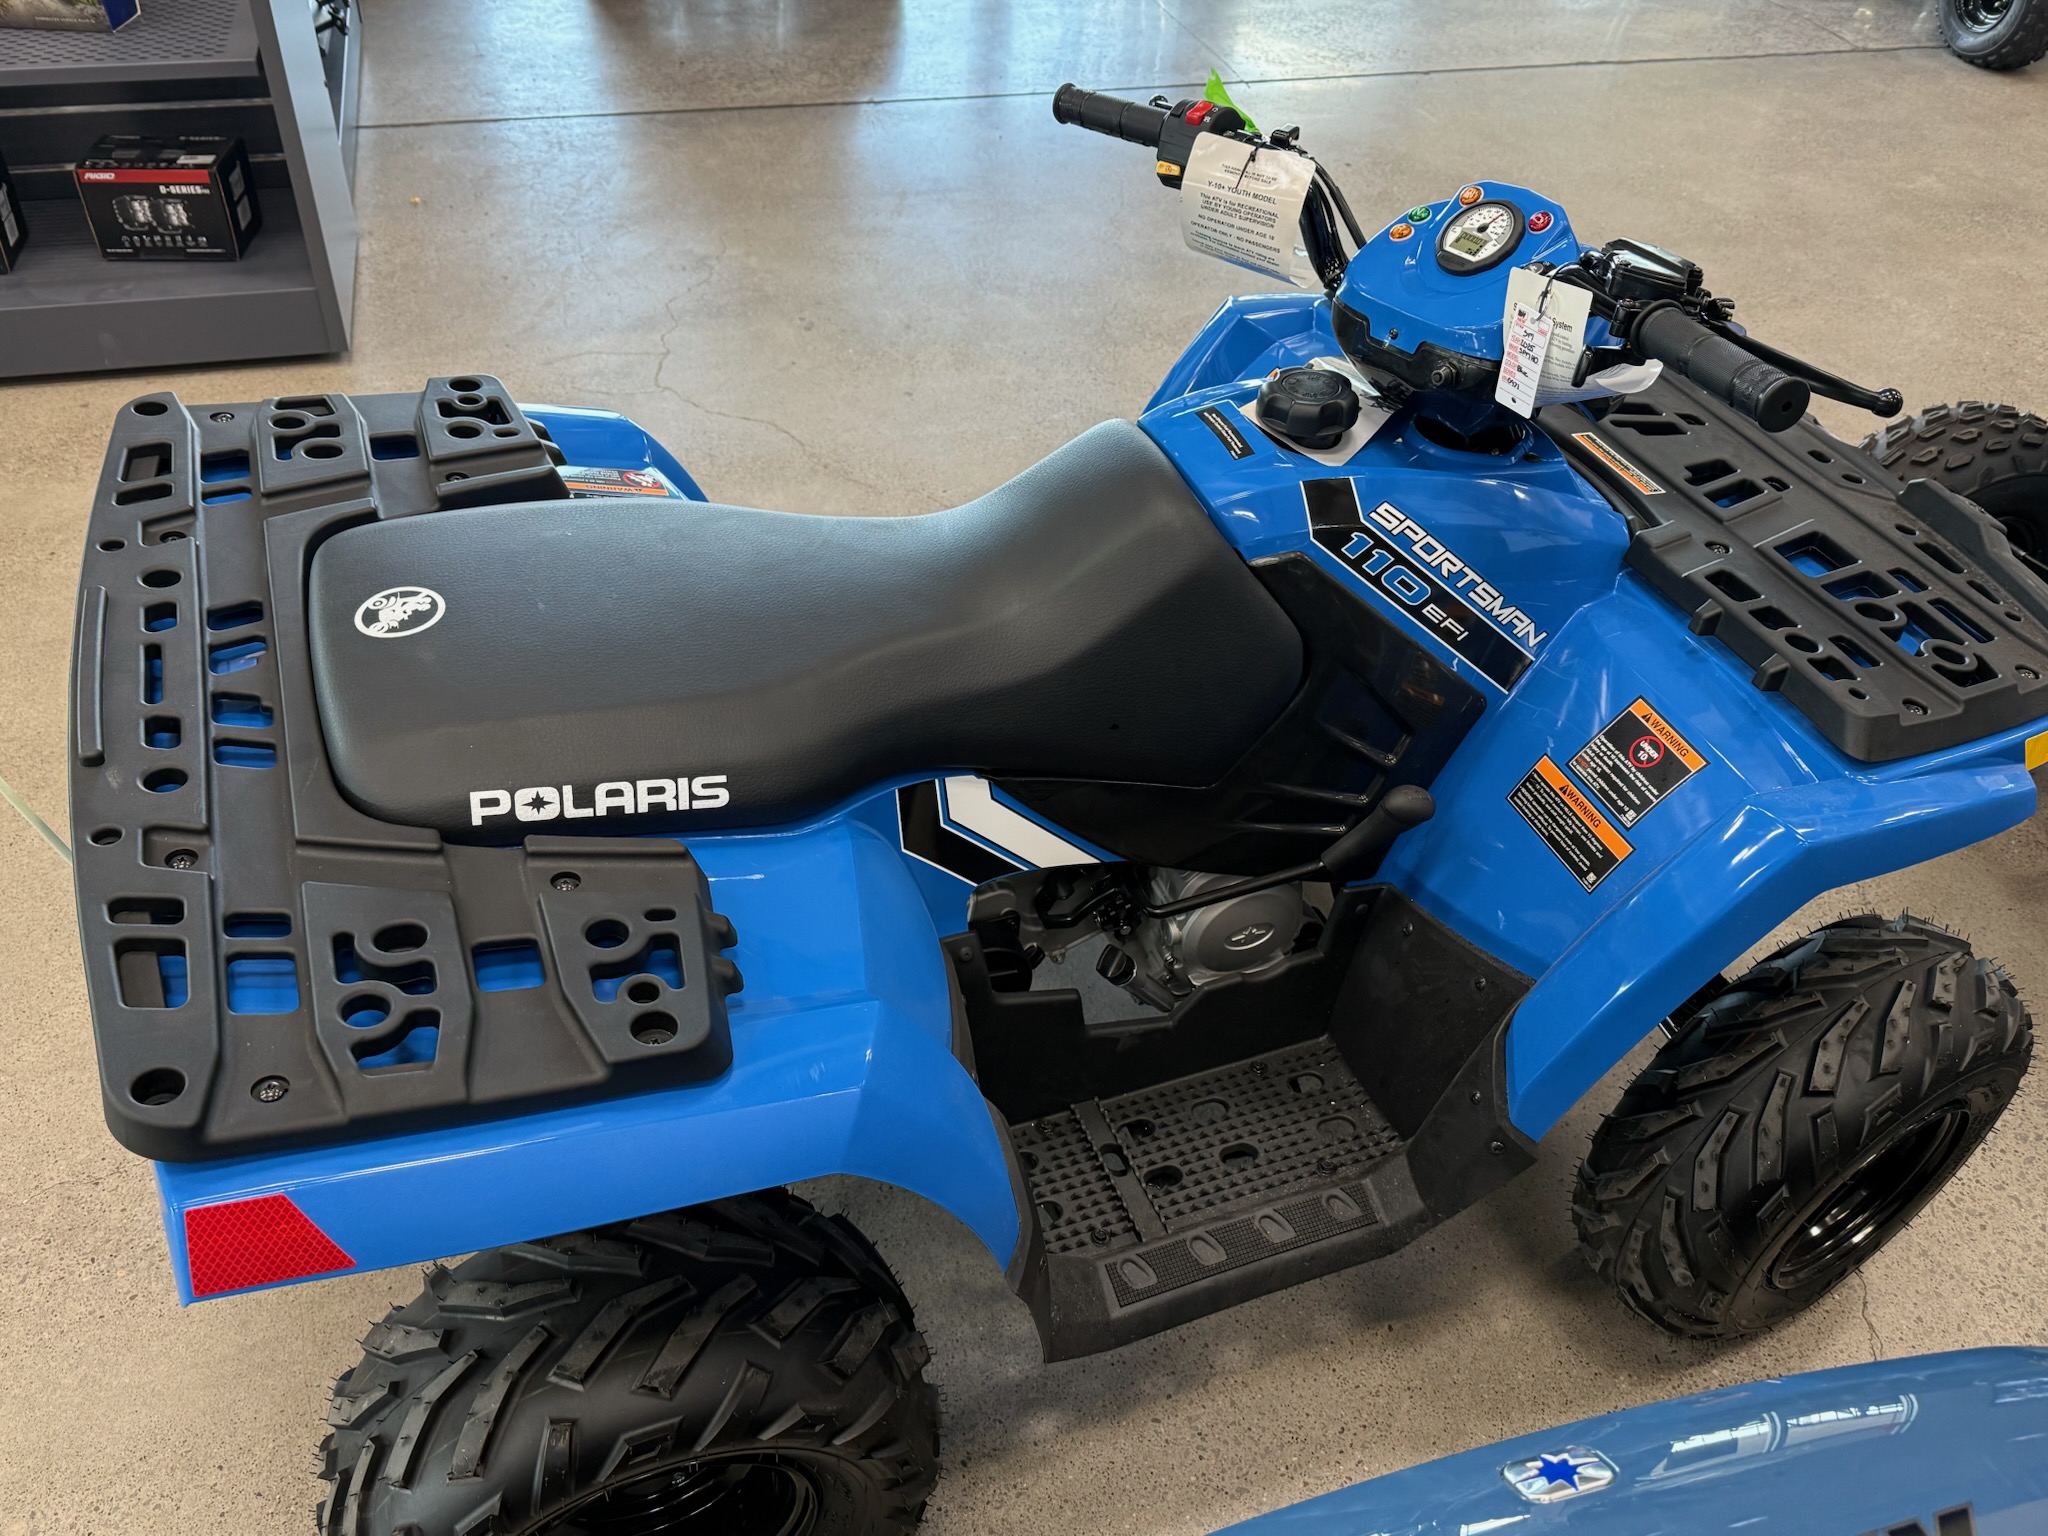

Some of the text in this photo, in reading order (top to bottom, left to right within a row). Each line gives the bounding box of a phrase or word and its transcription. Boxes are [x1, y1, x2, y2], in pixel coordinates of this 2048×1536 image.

[159, 184, 202, 194] D-SERIES
[1208, 181, 1277, 205] Y-10+ YOUTH MODEL
[1201, 204, 1274, 231] UNDER ADULT SUPERVISION
[1223, 204, 1242, 215] YOUNG
[1243, 209, 1276, 225] OPERATORS
[1237, 202, 1279, 220] RECREATIONAL
[1191, 220, 1217, 234] OPERATOR
[1219, 230, 1232, 238] ONLY
[1245, 236, 1280, 255] PASSENGERS
[1207, 216, 1235, 230] OPERATOR
[1236, 225, 1254, 235] UNDER
[1256, 230, 1267, 239] AGE
[1552, 318, 1572, 332] System
[1368, 500, 1549, 648] SPORTSMAN
[1340, 531, 1469, 642] 110 EFI
[1640, 740, 1659, 759] UNDER
[1650, 718, 1690, 758] WARNING
[1638, 750, 1649, 760] 10
[470, 775, 730, 826] POLARIS
[1566, 790, 1601, 828] WARNING
